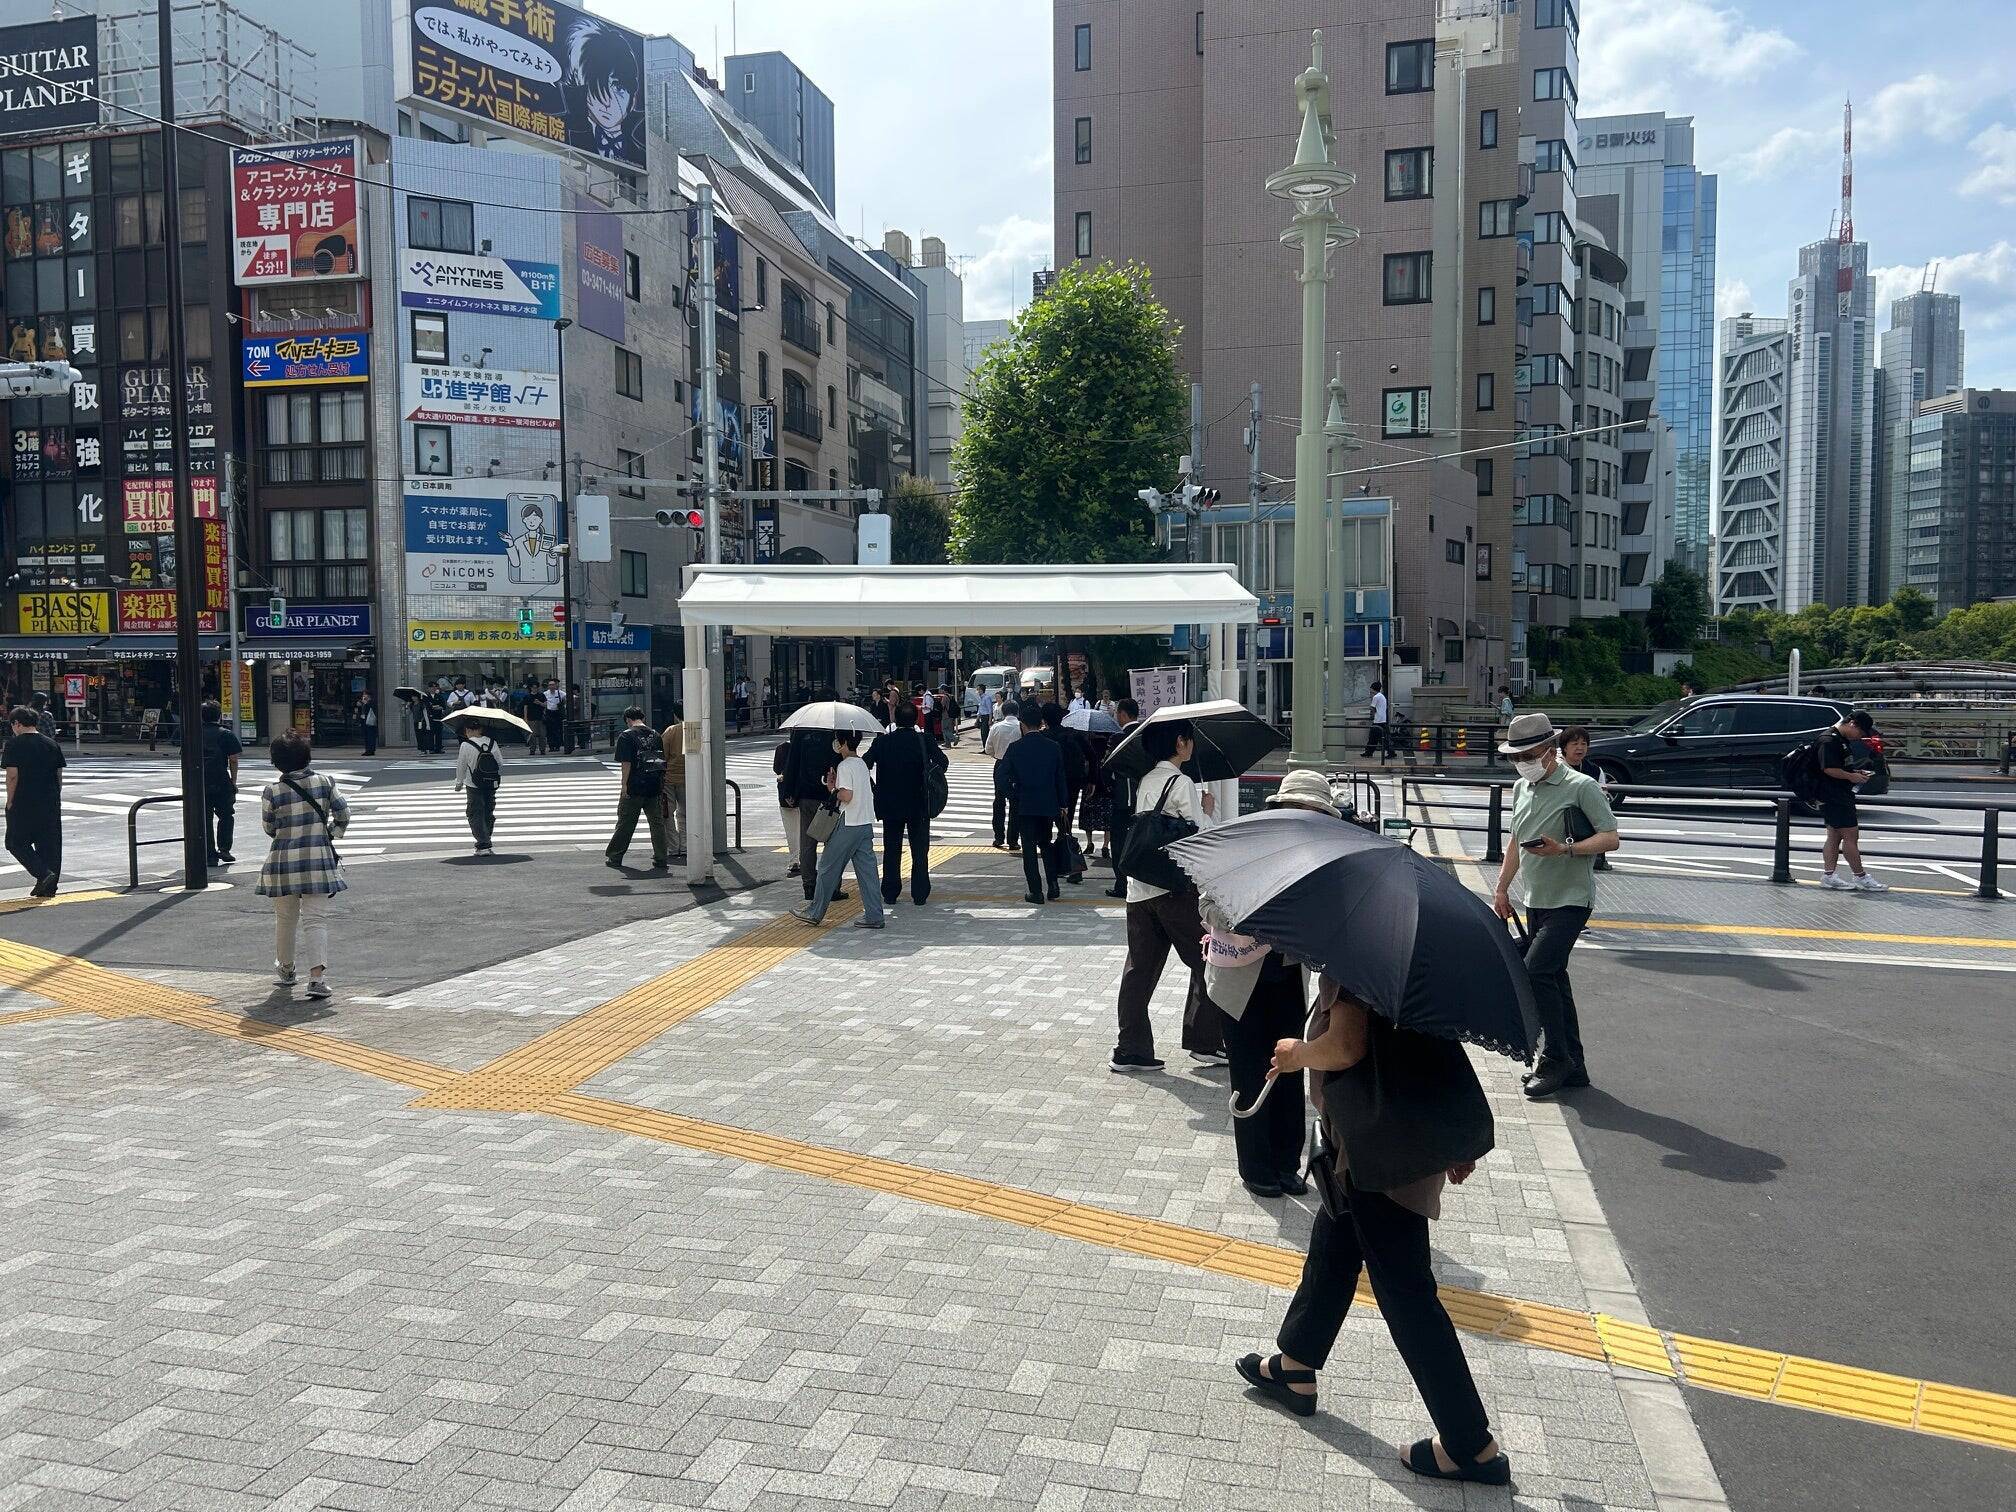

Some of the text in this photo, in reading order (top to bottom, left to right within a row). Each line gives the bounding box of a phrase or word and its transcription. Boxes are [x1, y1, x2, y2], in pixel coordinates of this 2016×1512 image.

[424, 15, 552, 74] では、私がやってみよう
[418, 72, 565, 142] ワタナベ国際病院
[1596, 130, 1656, 148] 日新火災
[247, 164, 342, 184] アコースティック
[257, 200, 334, 231] 専門店
[256, 261, 284, 275] 5分!!
[436, 265, 503, 280] ANYTIME
[436, 275, 503, 290] FITNESS
[521, 271, 555, 281] 約100m先
[531, 281, 555, 291] B1F
[427, 297, 538, 314] エニタイムフィットネス 御茶ノ水店
[247, 346, 270, 359] 70M
[276, 337, 359, 363] マツモトキヨシ
[285, 362, 350, 378] 処方せん受付
[421, 368, 503, 381] 難関中学受験指導
[445, 380, 511, 403] 進学館
[126, 488, 214, 519] 買取門
[421, 506, 493, 517] スマホが薬局に。
[141, 522, 174, 531] 0120-
[429, 520, 486, 531] 自宅でお薬が
[426, 535, 489, 546] 受け取れます。
[443, 567, 495, 578] NiCOMS
[31, 596, 93, 619] BASS
[306, 615, 359, 627] PLANET
[430, 630, 475, 640] 日本調剤
[285, 651, 332, 659] 0120-03-1959
